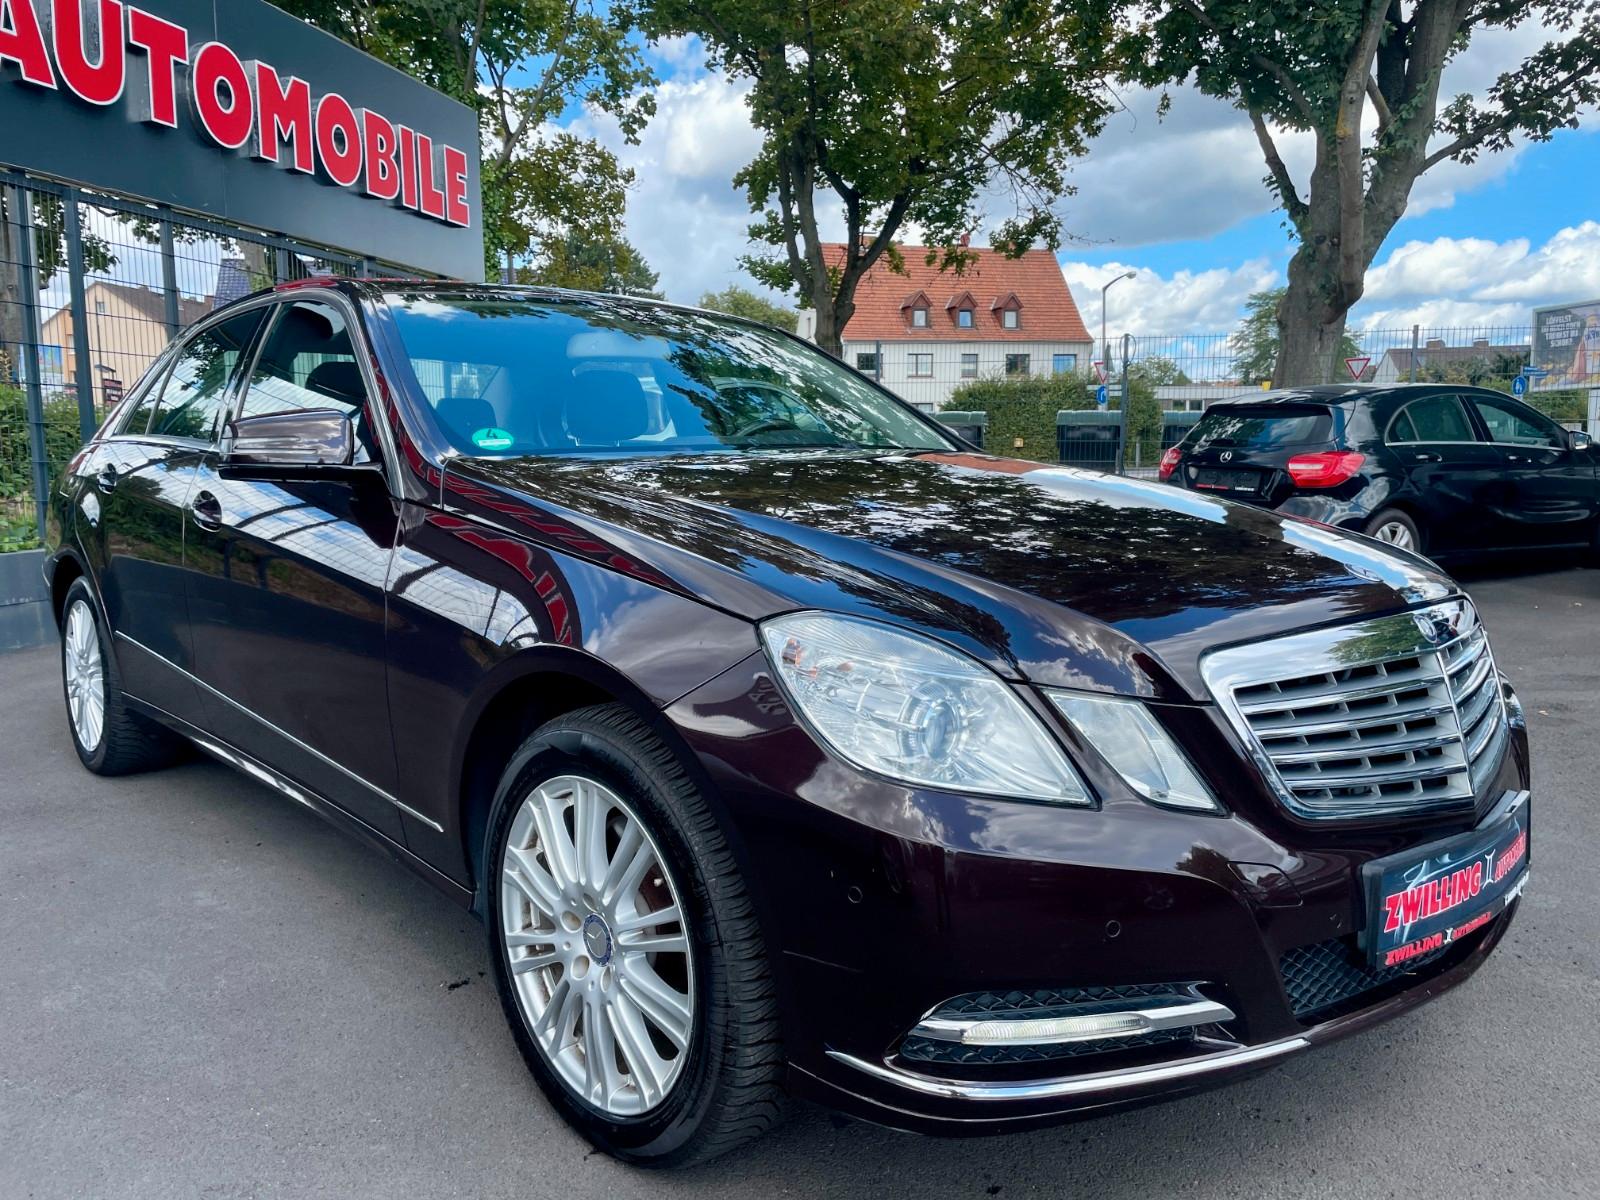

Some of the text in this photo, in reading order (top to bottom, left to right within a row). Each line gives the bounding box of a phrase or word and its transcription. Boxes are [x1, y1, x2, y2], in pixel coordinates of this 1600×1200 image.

[486, 428, 498, 439] 4
[1384, 861, 1482, 933] ZWILLING
[1385, 932, 1443, 966] ZWILLING
